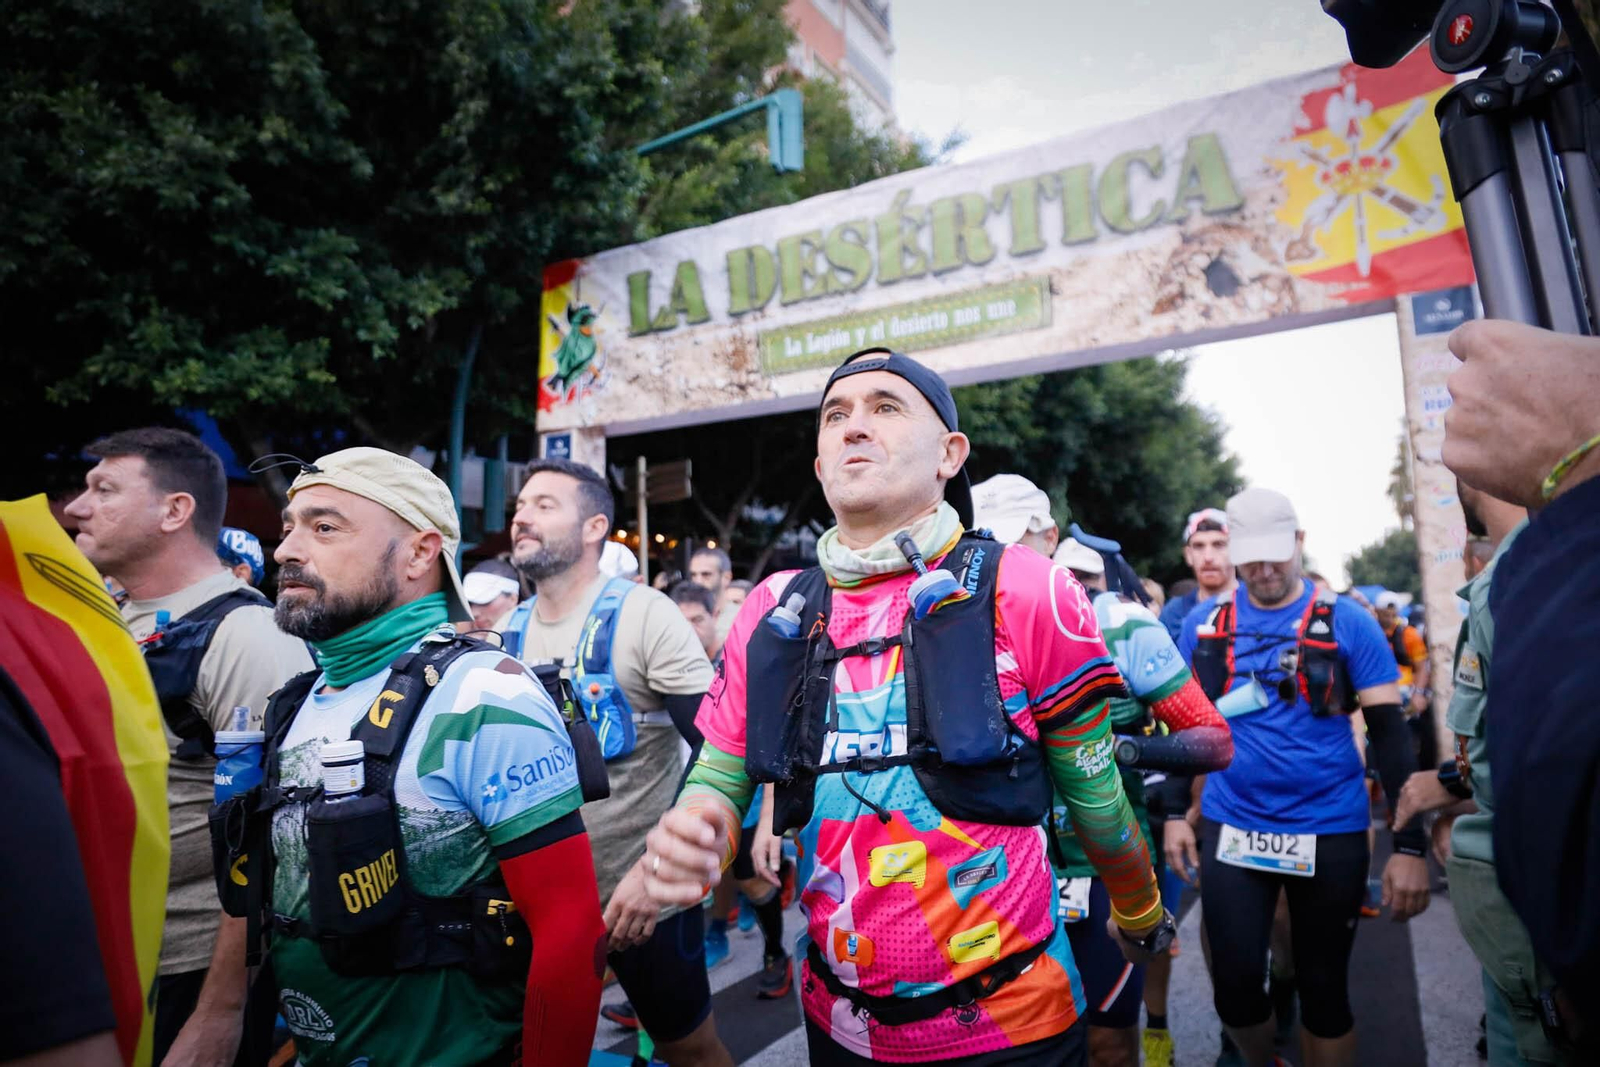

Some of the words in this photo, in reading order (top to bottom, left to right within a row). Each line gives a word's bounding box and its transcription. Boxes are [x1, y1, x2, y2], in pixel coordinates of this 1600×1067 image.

[627, 259, 709, 337] LA
[726, 132, 1246, 317] DESÉRTICA
[784, 336, 803, 358] La
[806, 328, 850, 355] Legión
[854, 326, 866, 347] y
[871, 318, 885, 340] el
[953, 304, 981, 326] nos
[987, 299, 1017, 320] une
[1246, 830, 1300, 856] 1502
[338, 848, 399, 914] GRIVEL
[295, 991, 335, 1028] ALUMINIO
